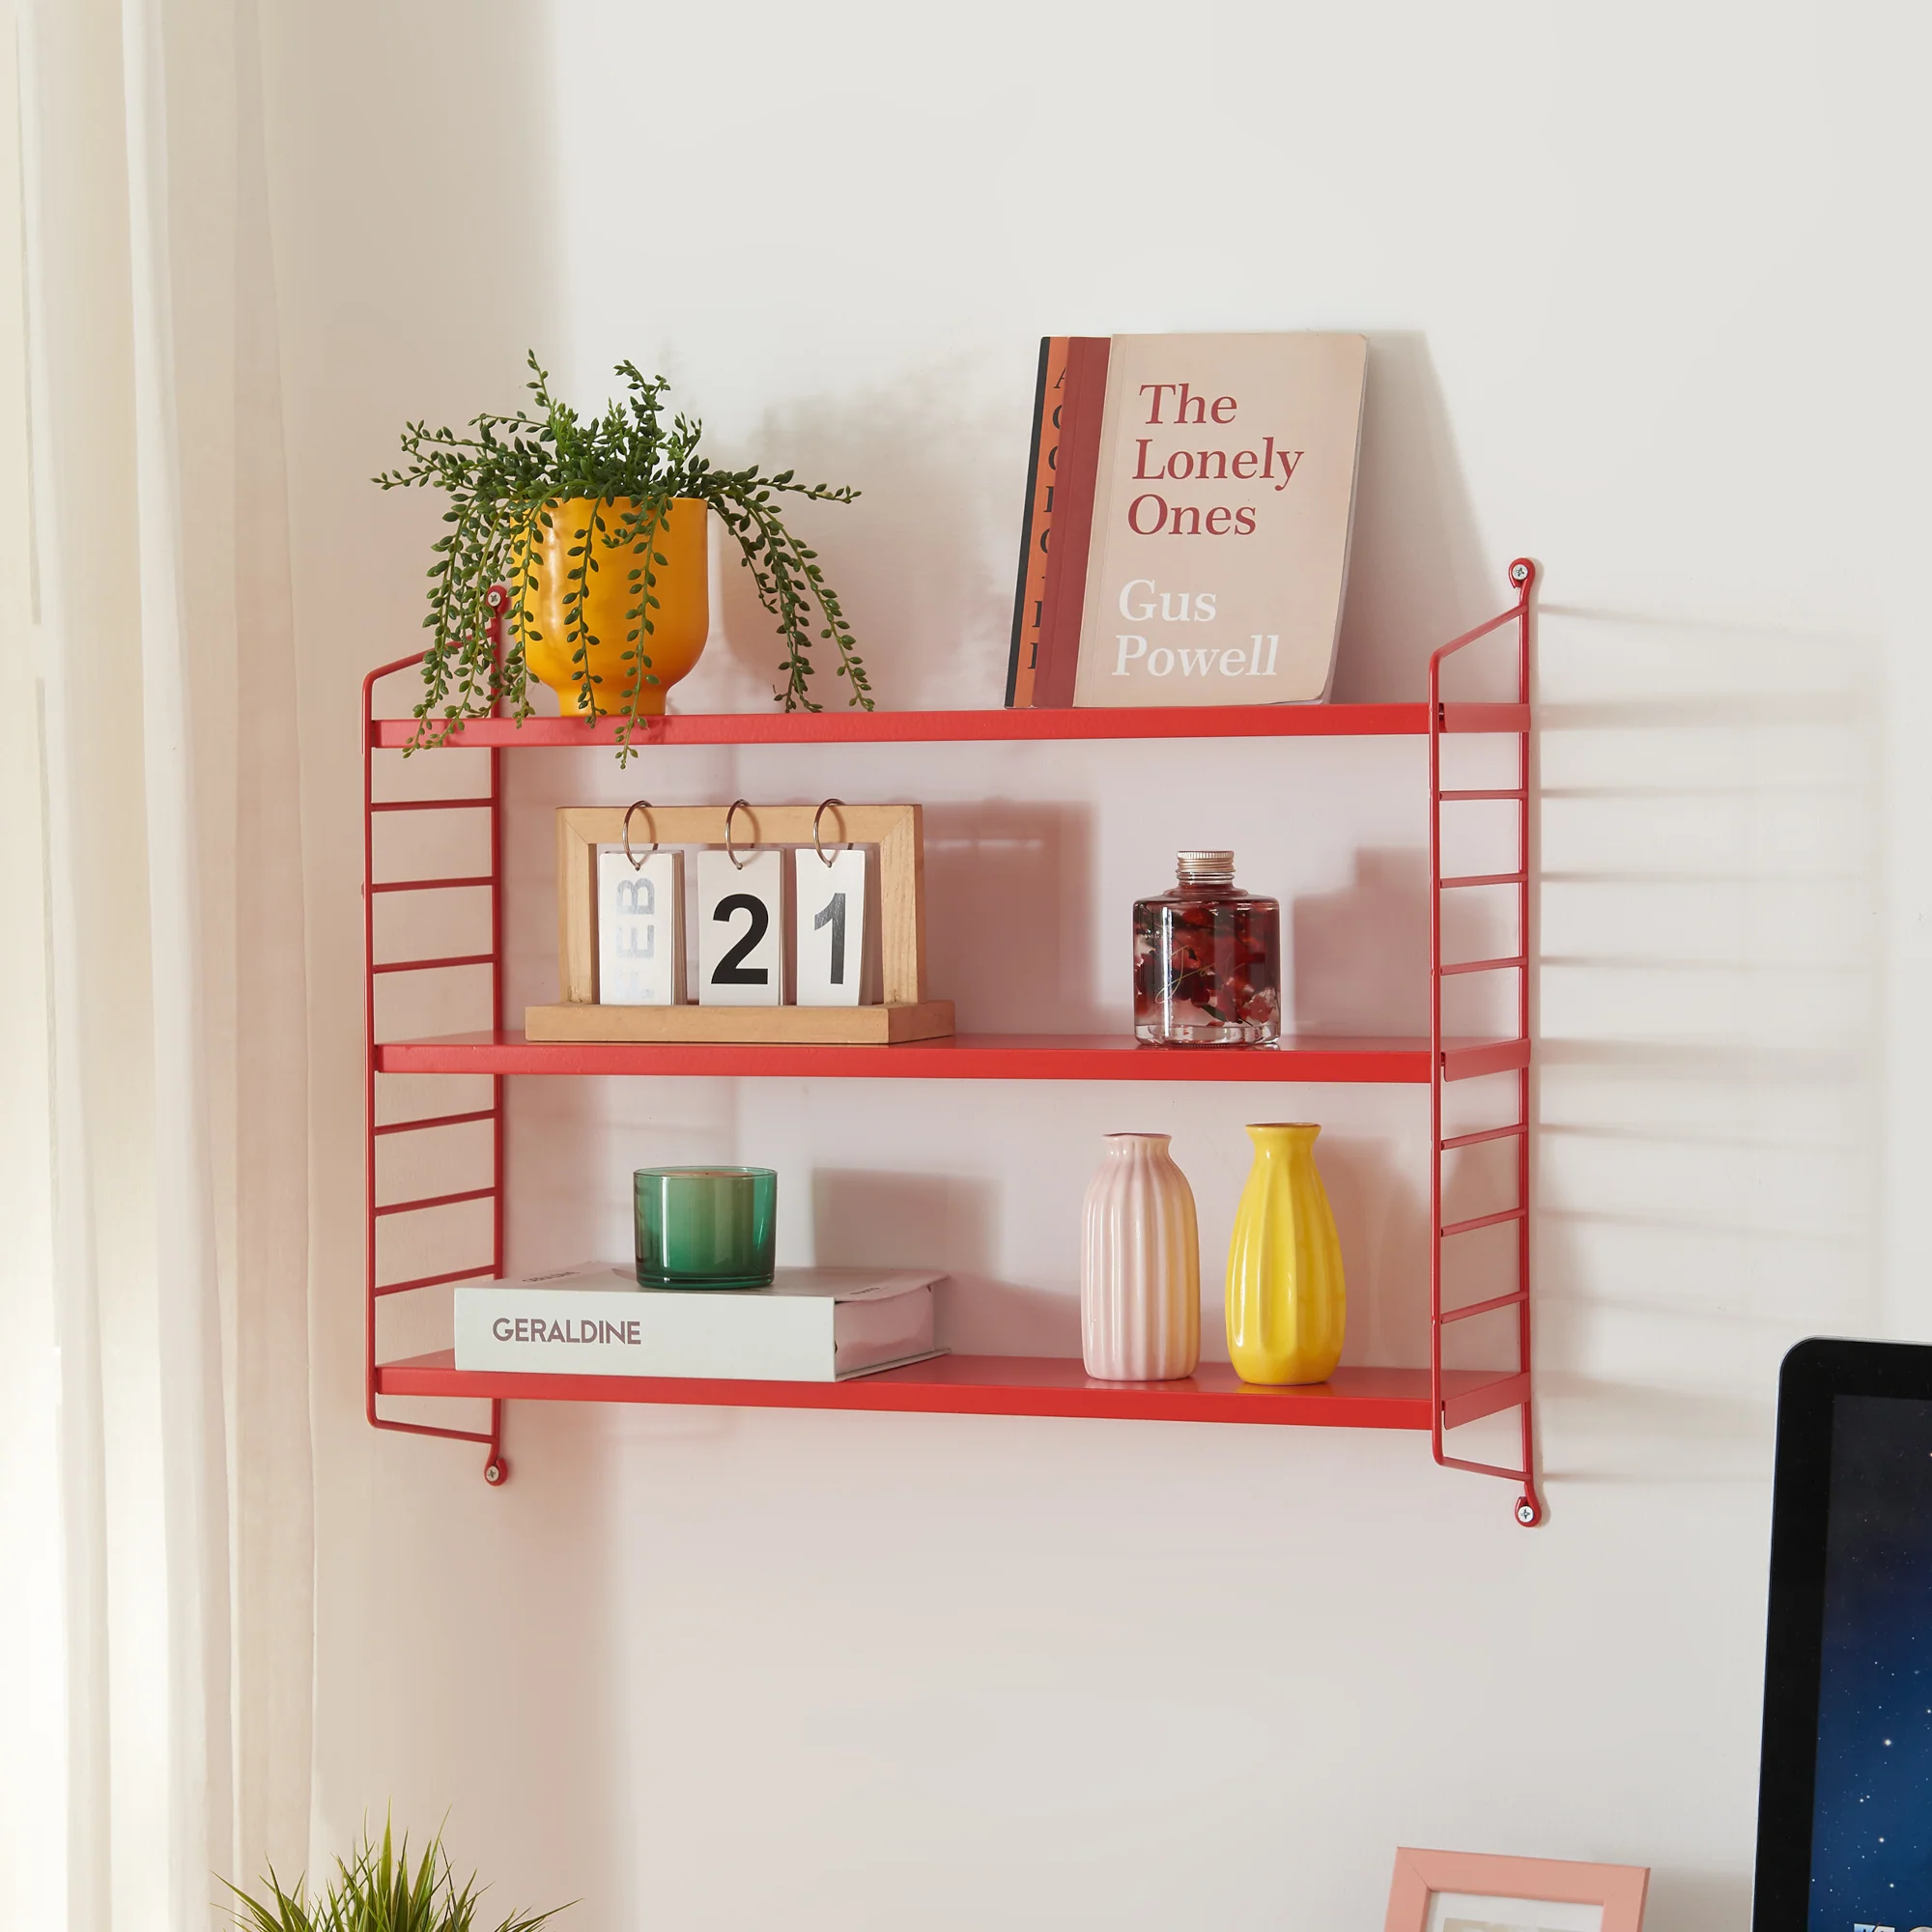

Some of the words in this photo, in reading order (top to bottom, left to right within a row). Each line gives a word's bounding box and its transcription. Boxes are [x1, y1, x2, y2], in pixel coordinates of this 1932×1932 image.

[1138, 383, 1237, 424] The
[1132, 437, 1305, 492] Lonely
[1127, 494, 1257, 535] Ones
[1118, 579, 1217, 622] Gus
[1111, 634, 1280, 677] Powell
[615, 877, 656, 1000] FEB
[710, 893, 769, 985] 2
[813, 893, 846, 985] 1
[492, 1318, 641, 1346] GERALDINE
